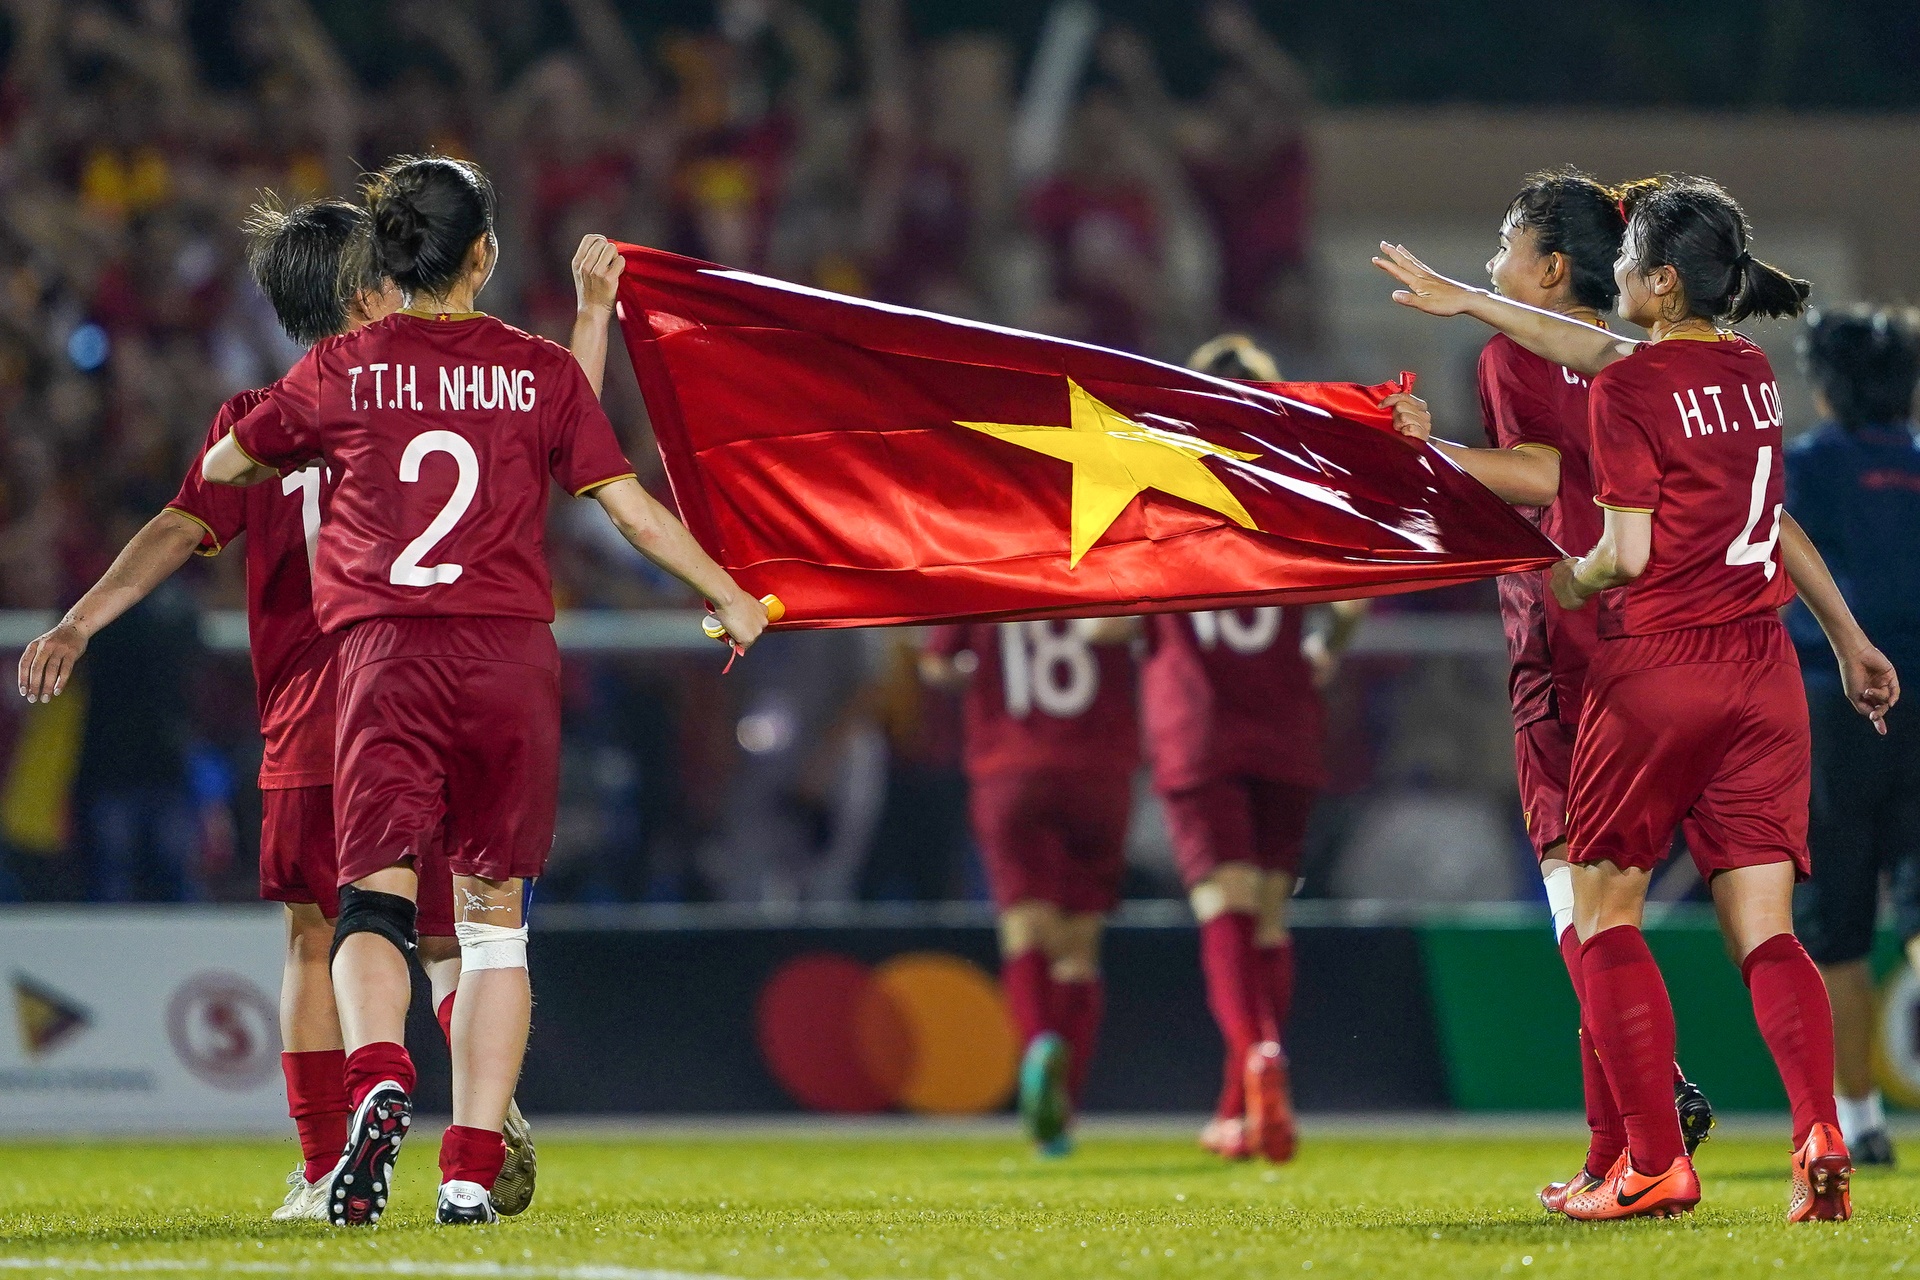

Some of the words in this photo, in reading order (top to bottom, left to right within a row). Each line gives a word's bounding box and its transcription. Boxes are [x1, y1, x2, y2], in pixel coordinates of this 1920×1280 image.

[348, 363, 424, 412] T.T.H.
[439, 365, 536, 412] NHUNG
[1672, 385, 1740, 439] H.T.
[389, 430, 480, 587] 2
[1726, 445, 1783, 582] 4
[1001, 617, 1098, 719] 18
